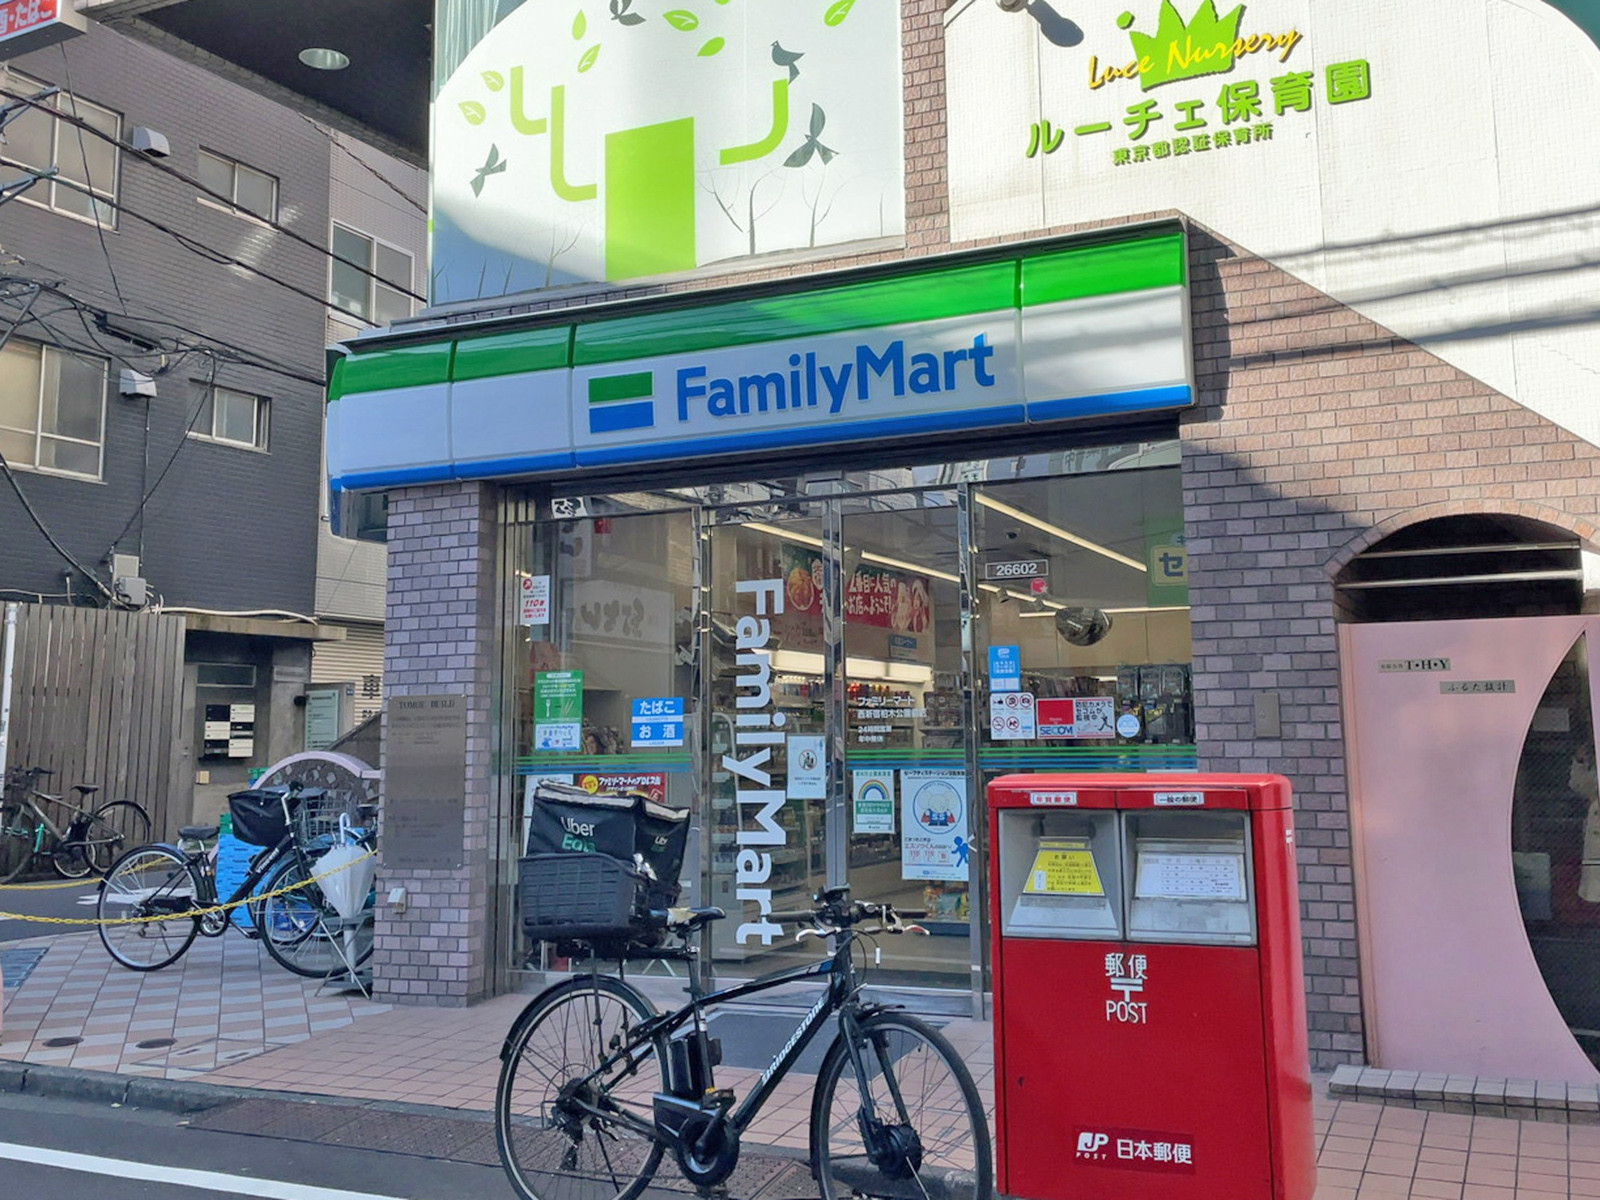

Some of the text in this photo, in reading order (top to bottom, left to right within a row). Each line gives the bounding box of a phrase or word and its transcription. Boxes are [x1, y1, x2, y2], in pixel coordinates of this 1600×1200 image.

[1088, 29, 1303, 89] Luce Nursery
[1111, 122, 1274, 166] 東京都認証保育所
[676, 332, 995, 422] FamilyMart
[995, 562, 1038, 577] 26602
[640, 700, 676, 715] たばこ
[857, 695, 915, 707] ファミリーマート
[1039, 726, 1074, 735] SECOM
[722, 578, 787, 945] FamilyMart
[560, 816, 595, 837] Uber
[1104, 952, 1148, 980] 郵便
[1105, 1000, 1148, 1024] POST
[1075, 1152, 1107, 1160] POST
[1116, 1138, 1193, 1165] 日本郵便
